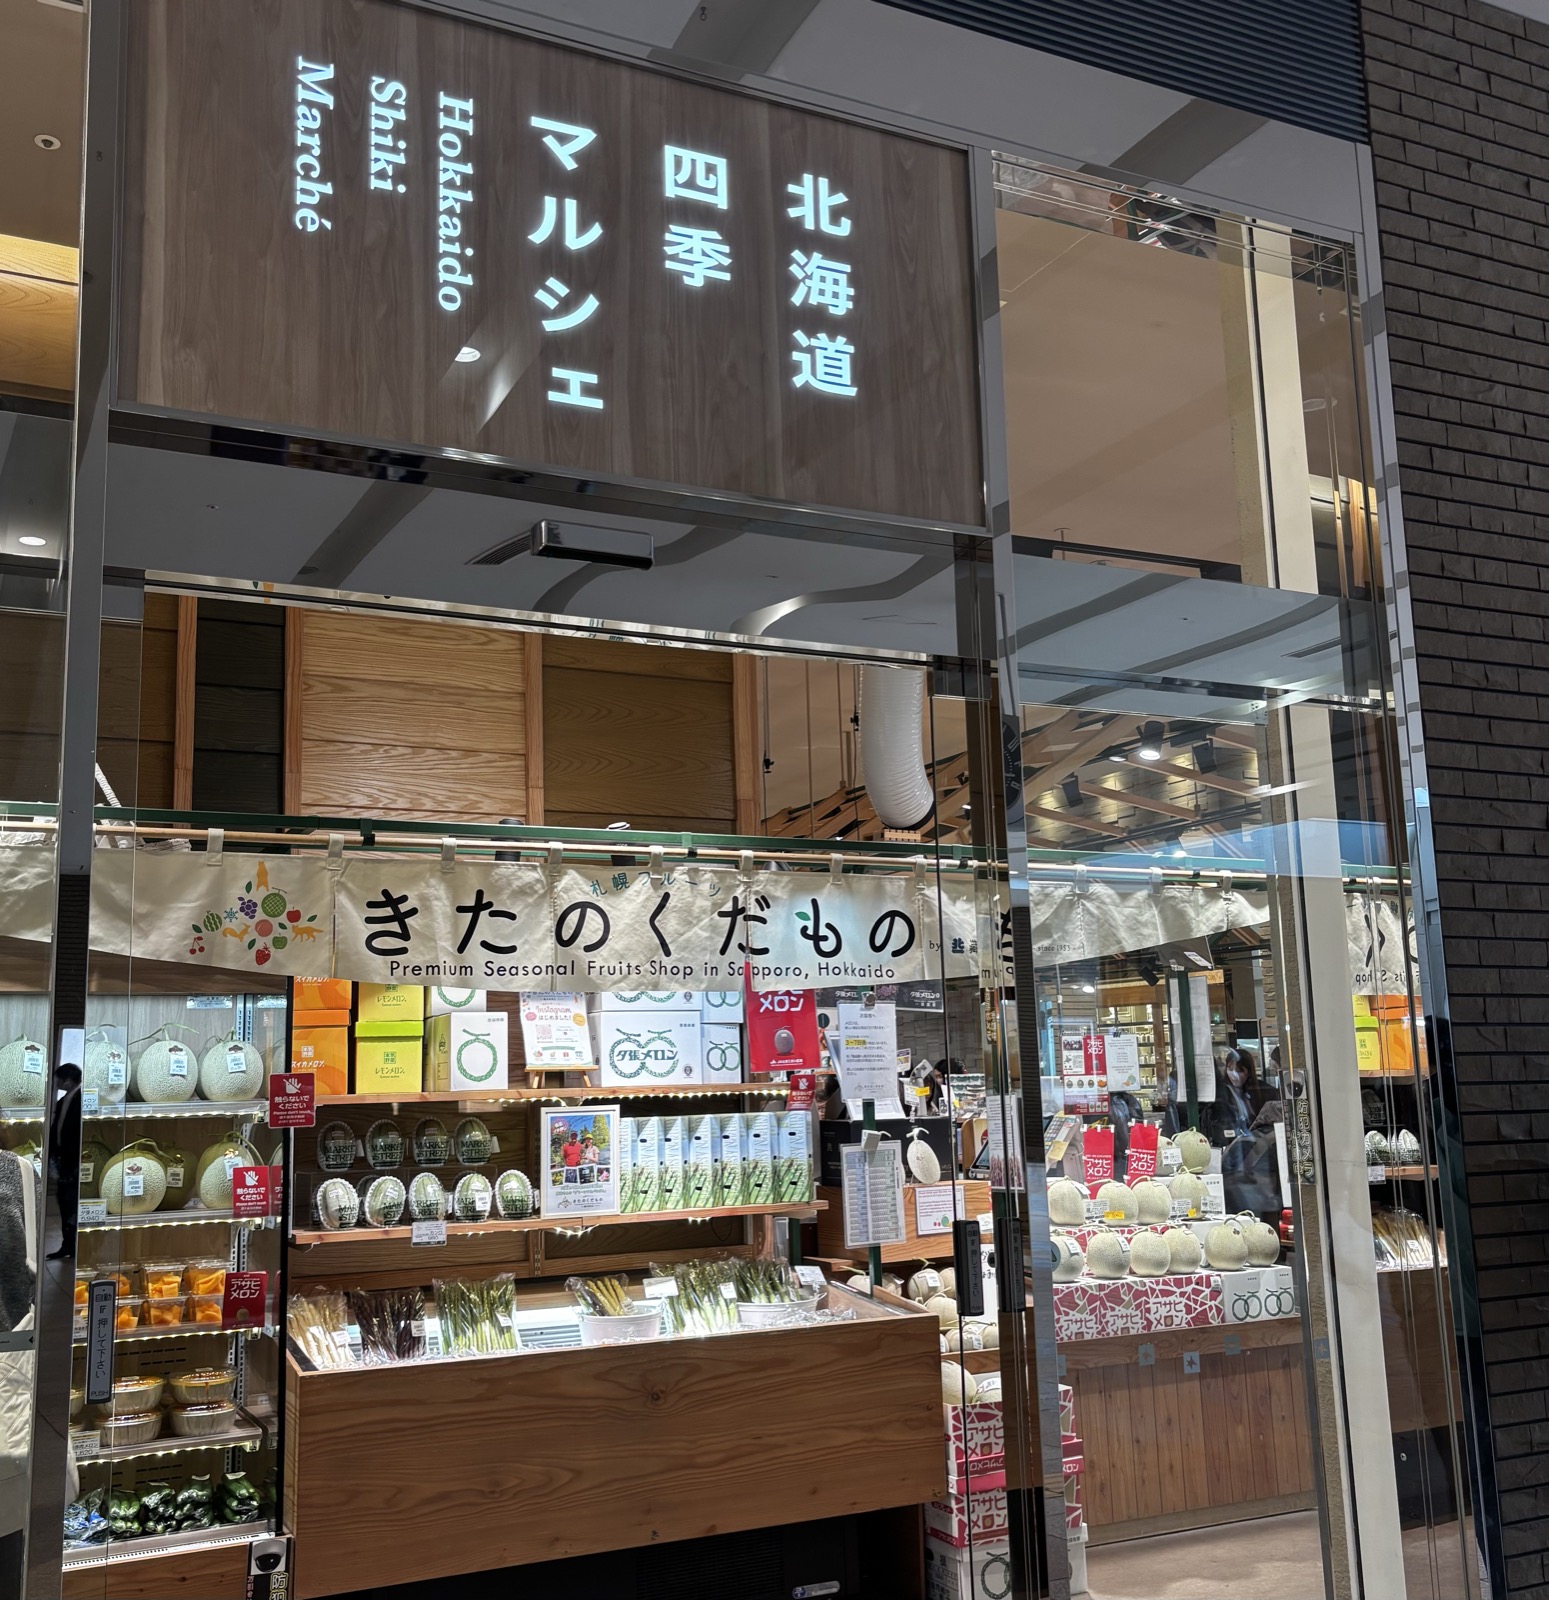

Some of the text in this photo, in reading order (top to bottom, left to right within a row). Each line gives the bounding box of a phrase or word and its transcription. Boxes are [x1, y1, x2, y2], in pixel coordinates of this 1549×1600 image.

[370, 76, 407, 194] Shiki
[296, 56, 334, 232] Marché
[438, 91, 474, 312] Hokkaido
[662, 144, 732, 288] 四季
[528, 115, 604, 410] マルシェ
[786, 172, 858, 397] 北海道
[590, 872, 721, 898] 札幌フルーツ
[364, 888, 916, 957] きたのくだもの
[929, 940, 941, 952] by
[390, 960, 895, 980] Premium Seasonal Fruits Shop in Sapporo, Hokkaido
[759, 994, 804, 1013] メロン
[615, 1049, 678, 1062] 夕張メロン
[274, 1095, 310, 1103] 触らないで
[1086, 1159, 1111, 1168] アサヒ
[1130, 1152, 1155, 1163] アサヒ
[1087, 1167, 1111, 1177] メロン
[1130, 1162, 1154, 1171] メロン
[236, 1187, 266, 1195] 触らないで
[230, 1279, 261, 1290] アサヒ
[230, 1290, 260, 1300] メロン
[1152, 1300, 1184, 1314] アサヒ
[1063, 1317, 1094, 1332] アサヒ
[1110, 1312, 1139, 1326] アサヒ
[1154, 1314, 1185, 1328] メロン
[967, 1425, 1004, 1442] アサヒ
[967, 1441, 1005, 1458] メロン
[970, 1496, 1007, 1514] アサヒ
[970, 1512, 1007, 1530] メロン
